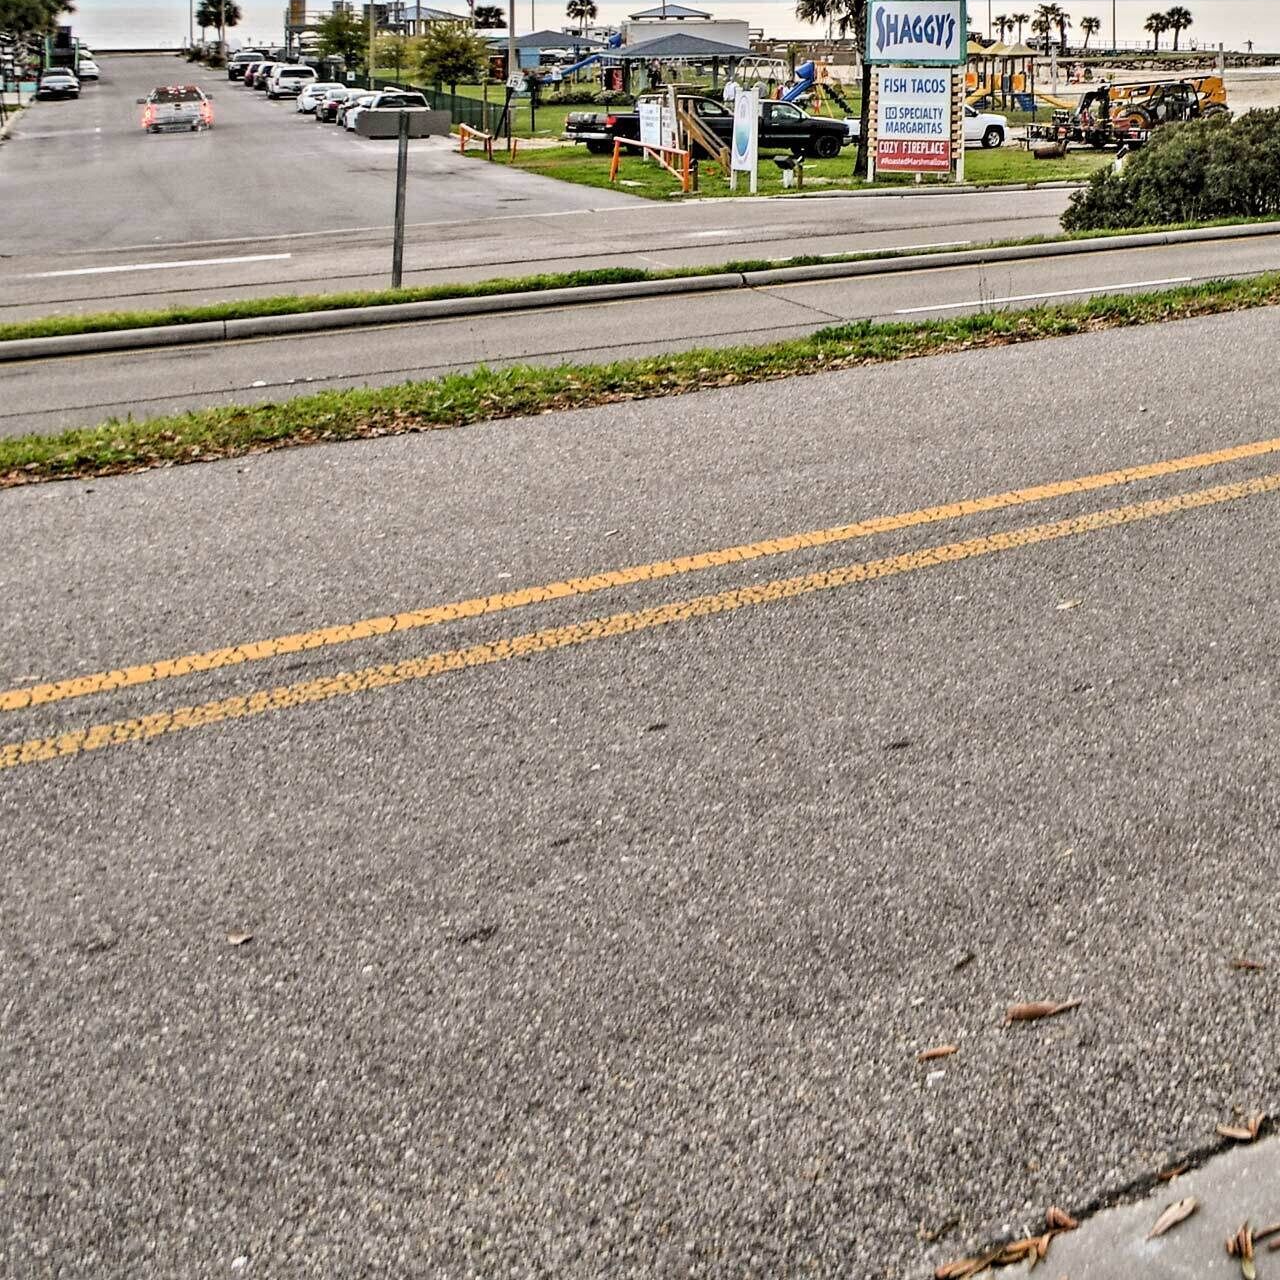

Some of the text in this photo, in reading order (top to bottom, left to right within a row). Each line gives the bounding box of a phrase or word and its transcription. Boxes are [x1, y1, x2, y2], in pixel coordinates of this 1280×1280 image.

[875, 6, 956, 54] SHAGGY'S
[884, 78, 946, 93] FISH TACOS
[885, 106, 944, 120] 10 SPECIALTY
[885, 121, 943, 134] MARGARITAS
[879, 141, 945, 154] COZY FIREPLACE
